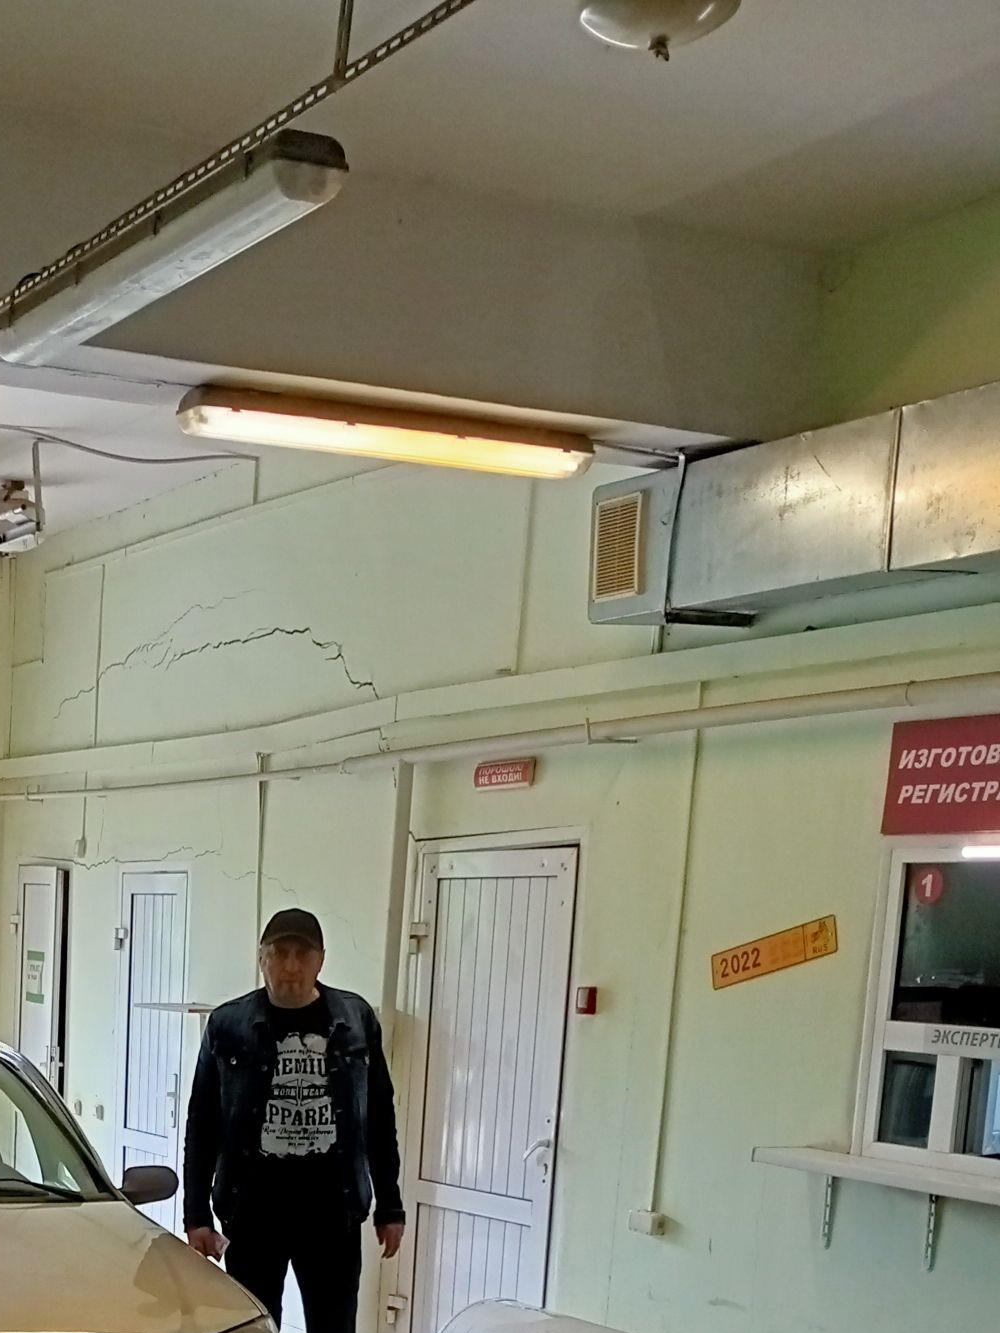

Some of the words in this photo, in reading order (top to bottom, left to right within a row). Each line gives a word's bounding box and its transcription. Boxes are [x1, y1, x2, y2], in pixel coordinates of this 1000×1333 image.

[898, 744, 1000, 769] ИЗГОТОВ
[479, 775, 490, 785] НЕ
[921, 874, 934, 897] 1
[720, 948, 761, 978] 2022
[931, 1029, 1000, 1049] ЭКСПЕРТ
